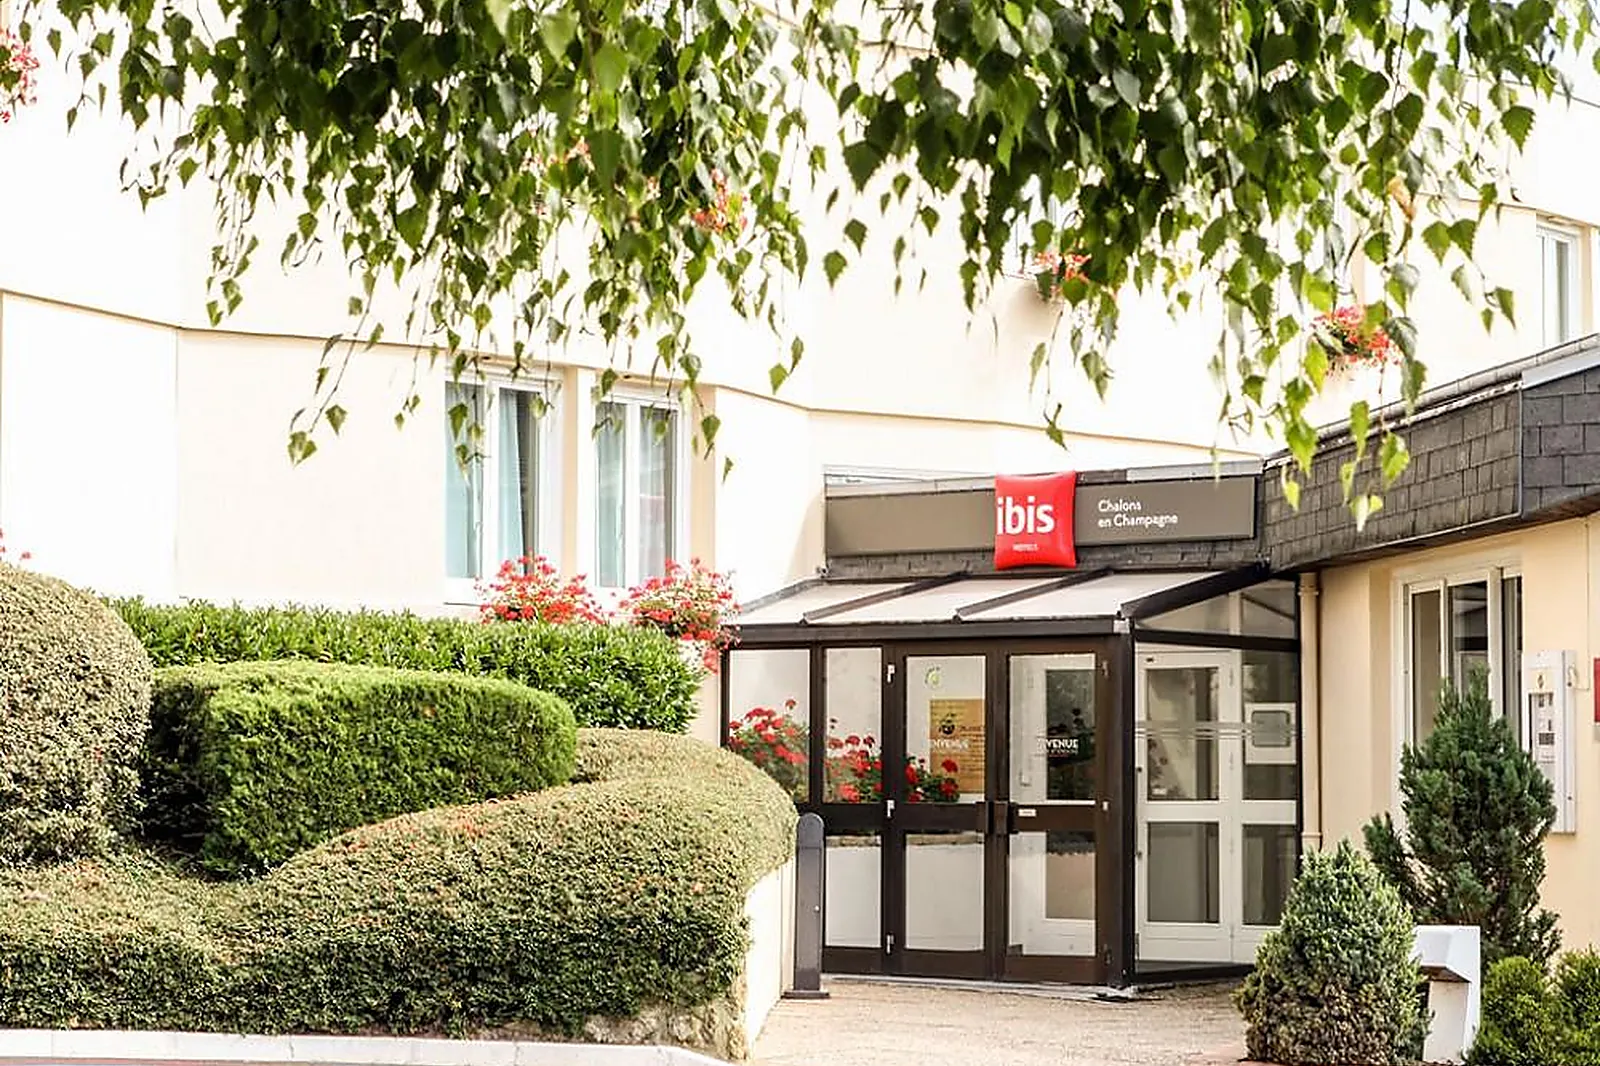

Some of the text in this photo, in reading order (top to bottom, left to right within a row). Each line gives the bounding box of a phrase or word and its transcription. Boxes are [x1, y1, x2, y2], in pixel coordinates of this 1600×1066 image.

[1098, 499, 1142, 512] Chalons
[996, 496, 1055, 535] ibis
[1098, 513, 1178, 529] en Champagne
